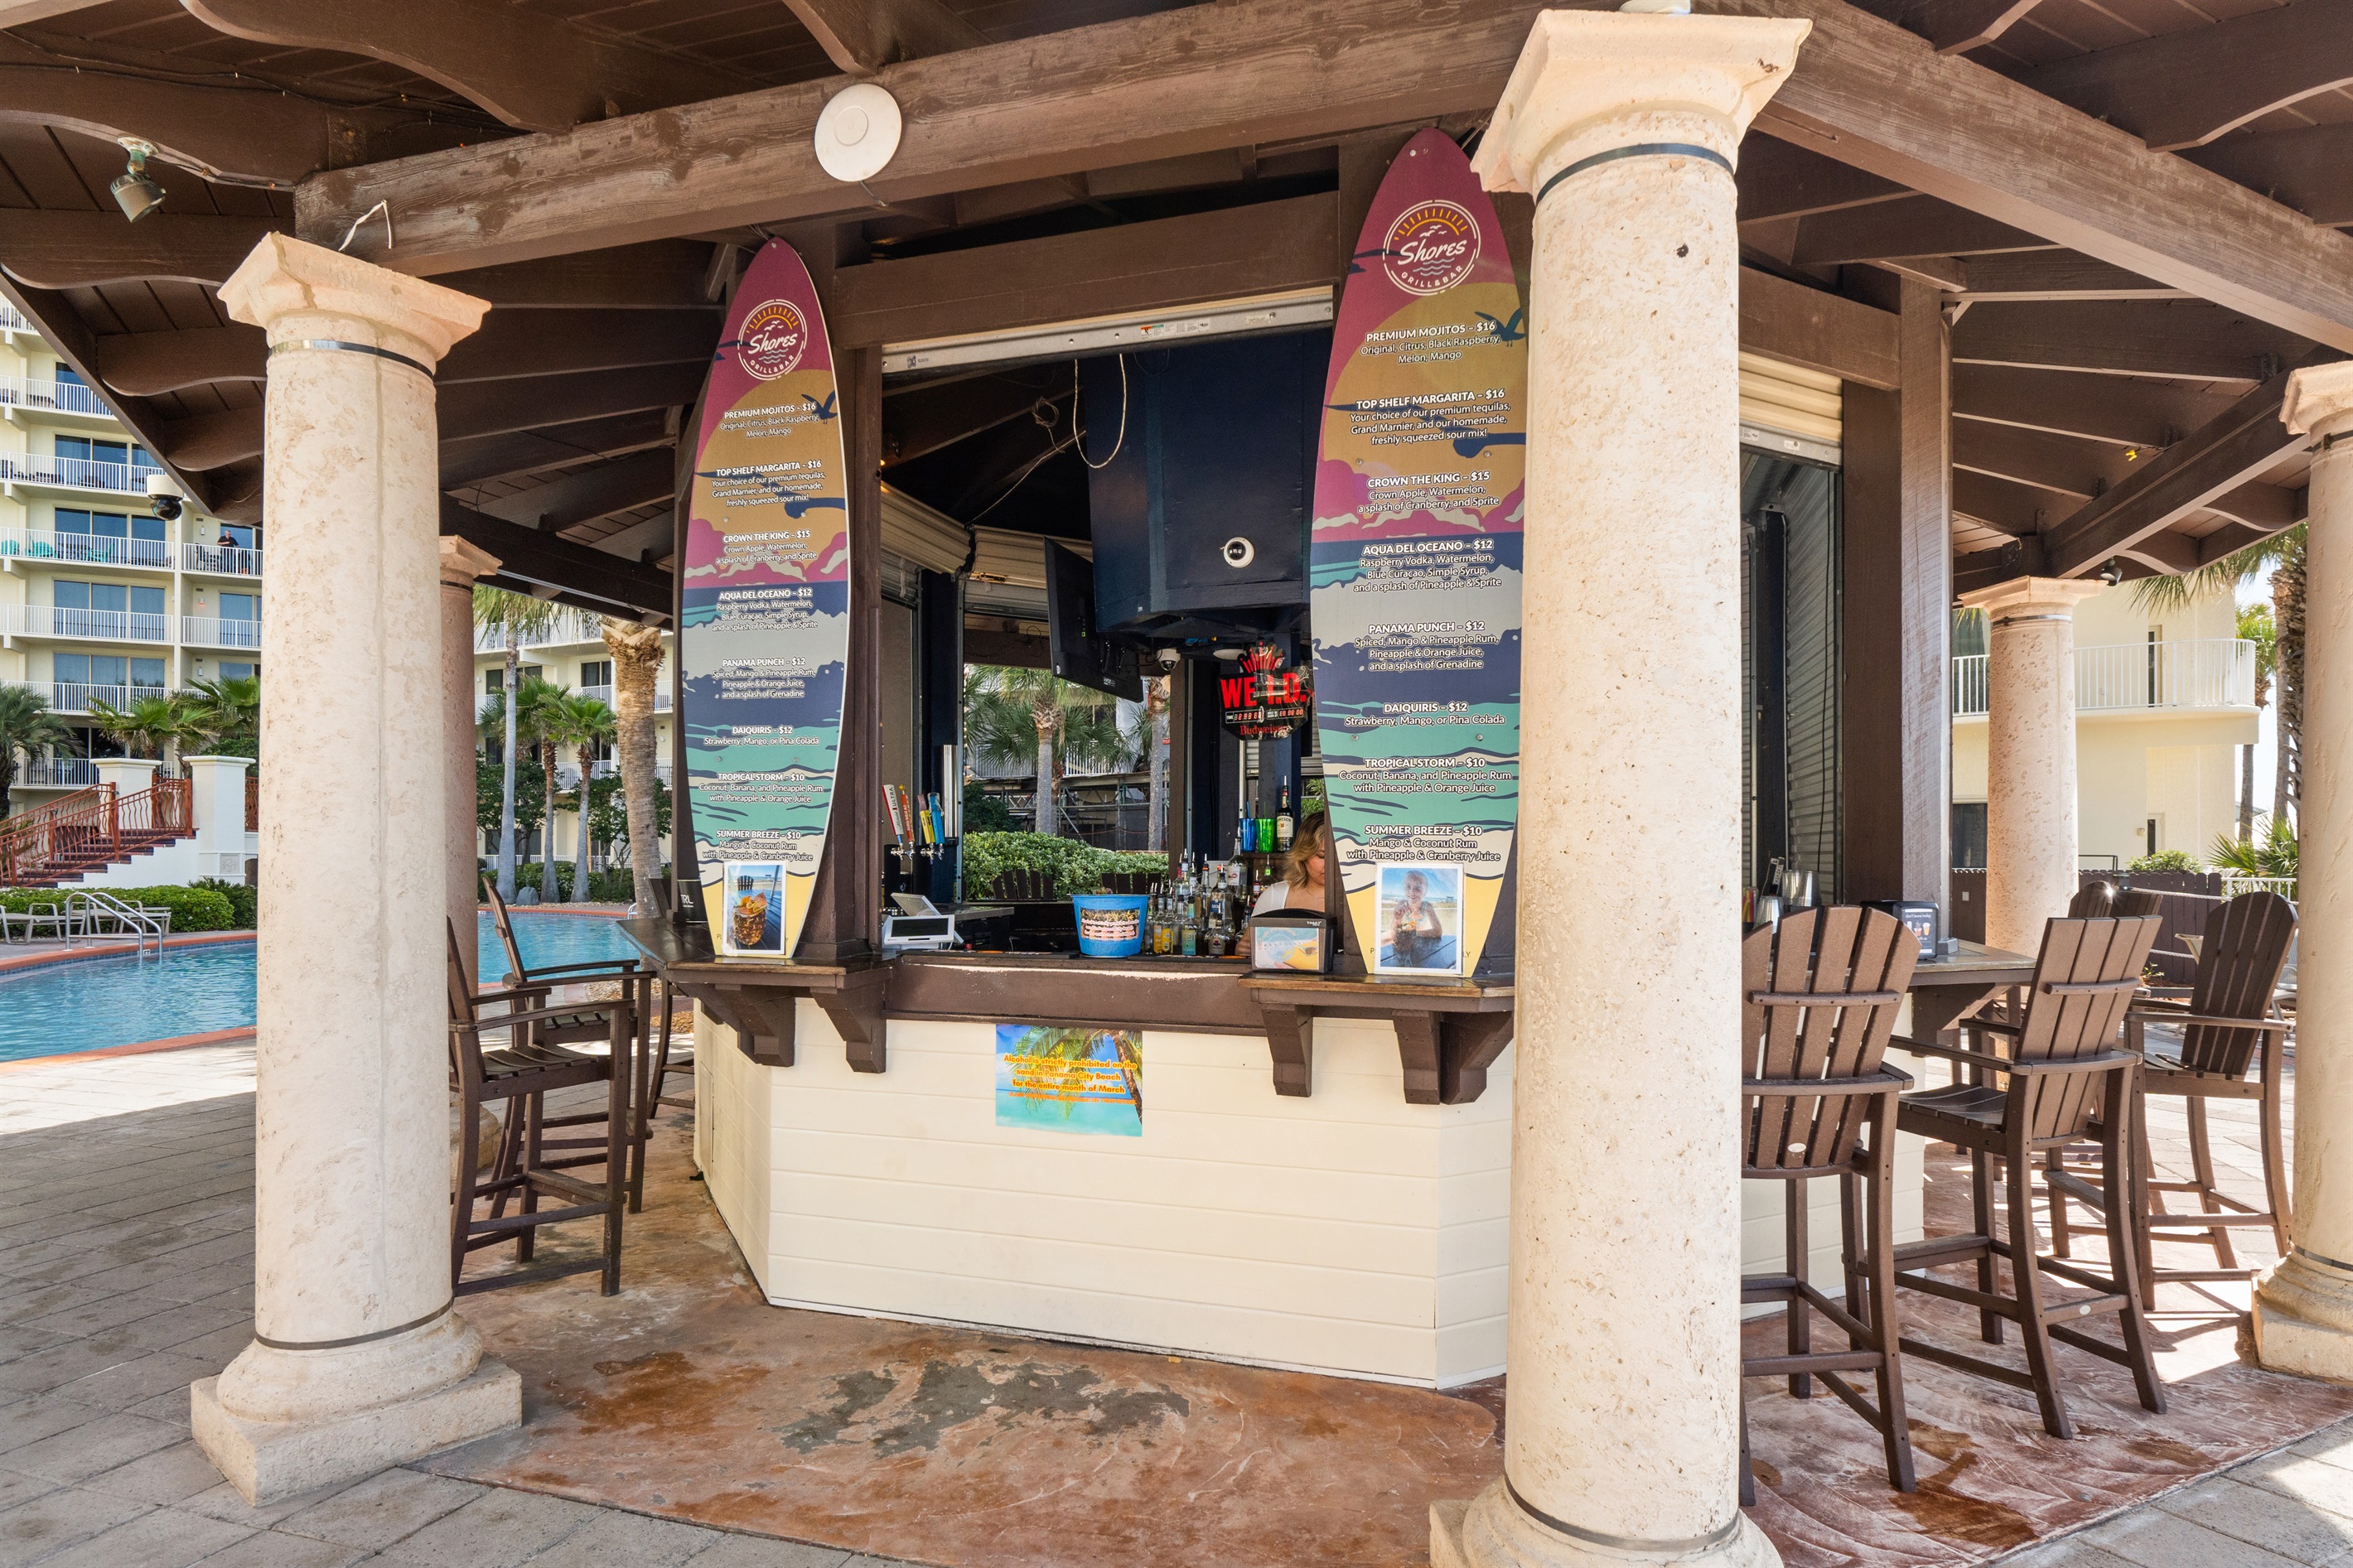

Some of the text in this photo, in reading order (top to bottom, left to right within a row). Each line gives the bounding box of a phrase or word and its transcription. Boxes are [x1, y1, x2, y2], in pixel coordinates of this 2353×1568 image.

[1397, 238, 1467, 266] Shores
[1366, 322, 1496, 342] PREMIUM MOJITOS $16
[747, 332, 798, 355] Shores
[1360, 336, 1500, 355] Original, Citrus, Black Raspberry,
[1398, 352, 1462, 364] Melon, Mango
[1356, 389, 1505, 410] TOP SHELF MARGARITA $16
[724, 403, 817, 419] PREMIUM MOJITOS $16
[1350, 413, 1370, 422] Your
[1371, 411, 1400, 420] choice
[1402, 409, 1412, 418] of
[1430, 406, 1471, 417] premium
[1472, 403, 1511, 414] tequilas,
[1350, 425, 1377, 434] Grand
[1379, 422, 1415, 432] Marnier,
[1416, 420, 1433, 430] and
[1452, 416, 1507, 427] homemade,
[1371, 435, 1400, 445] freshly
[1402, 432, 1444, 444] squeezed
[1468, 428, 1487, 437] mix!
[716, 461, 822, 476] TOP SHELF MARGARITA $16
[1367, 471, 1491, 488] CROWN THE KING $15
[1370, 485, 1486, 499] Crown Apple, Watermelon,
[1365, 503, 1393, 514] splash
[1394, 502, 1404, 510] of
[1405, 501, 1452, 510] Cranberry,
[1452, 499, 1470, 507] and
[1471, 497, 1500, 508] Sprite
[1363, 540, 1493, 556] AQUA DEL OCEANO $12
[1360, 554, 1495, 568] Raspberry Vodka, Watermelon,
[1367, 571, 1386, 579] Blue
[1428, 567, 1458, 577] Simple
[1460, 567, 1488, 577] Syrup,
[1354, 583, 1370, 591] and
[1379, 581, 1408, 592] splash
[1409, 581, 1419, 590] of
[1420, 580, 1464, 590] Pineapple
[1466, 579, 1475, 587] &
[1474, 578, 1501, 588] Sprite
[718, 588, 812, 601] AQUA DEL OCEANO $12
[1369, 621, 1485, 634] PANAMA PUNCH $12
[1355, 635, 1499, 648] Spiced, Mango & Pineapple Rum,
[1370, 649, 1413, 659] Pineapple
[1423, 649, 1457, 659] Orange
[1457, 648, 1484, 657] Juice,
[1370, 662, 1386, 670] and
[1395, 661, 1423, 672] splash
[1425, 661, 1435, 669] of
[1436, 660, 1483, 668] Grenadine
[1220, 672, 1307, 709] WE I.D.
[1384, 702, 1467, 713] DAIQUIRIS $12
[1345, 716, 1398, 726] Strawberry,
[1399, 716, 1434, 726] Mango,
[1471, 716, 1505, 724] Colada
[732, 726, 793, 735] DAIQUIRIS $12
[1365, 758, 1486, 769] TROPICAL STORM $10
[1339, 771, 1511, 782] Coconut, Banana, and Pineapple Rum
[1354, 784, 1495, 794] with Pineapple & Orange Juice
[751, 831, 780, 839] BREEZE
[787, 831, 801, 840] $10
[1365, 826, 1482, 837] SUMMER BREEZE $10
[1369, 839, 1476, 849] Mango & Coconut Rum
[1346, 851, 1500, 862] with Pineapple & Cranberry Juice
[1003, 1054, 1032, 1064] Alcohol
[1041, 1056, 1067, 1067] strictly
[1069, 1059, 1109, 1068] prohibited
[1124, 1060, 1138, 1069] the
[1036, 1069, 1043, 1077] in
[1045, 1069, 1075, 1078] Panama
[1078, 1071, 1094, 1081] City
[1095, 1072, 1121, 1080] Beach
[1012, 1078, 1023, 1087] for
[1025, 1079, 1036, 1088] the
[1038, 1081, 1061, 1089] entire
[1061, 1083, 1086, 1091] month
[1099, 1083, 1125, 1093] March
